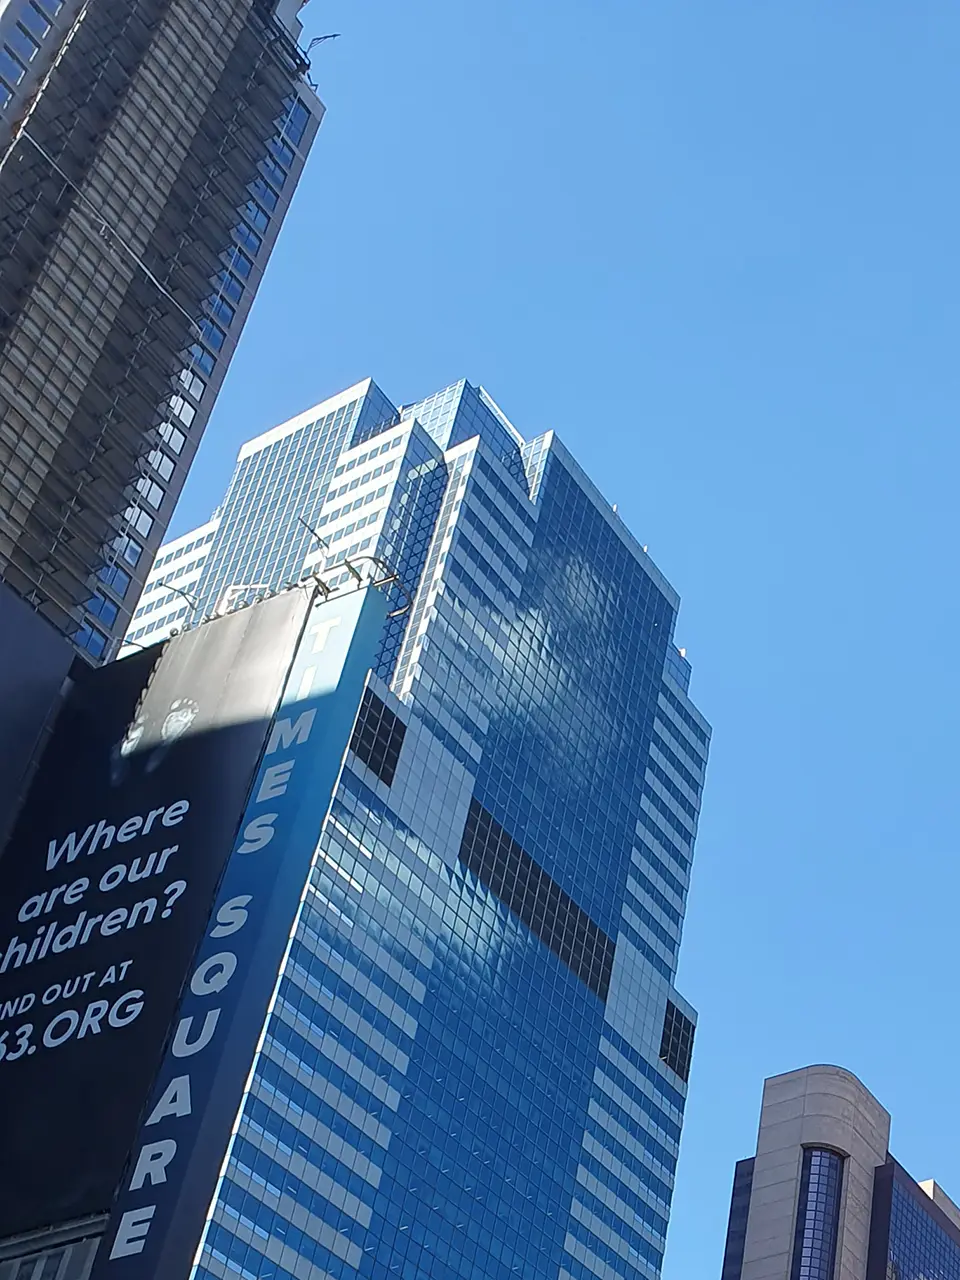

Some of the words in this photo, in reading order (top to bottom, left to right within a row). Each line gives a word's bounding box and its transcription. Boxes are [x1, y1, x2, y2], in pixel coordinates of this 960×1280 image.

[236, 616, 342, 855] TIMES
[46, 799, 190, 871] Where
[18, 877, 90, 922] are
[99, 845, 179, 892] our
[0, 880, 187, 974] hildren?
[42, 971, 96, 1005] OUT
[99, 960, 134, 988] AT
[109, 895, 250, 1262] SQUARE
